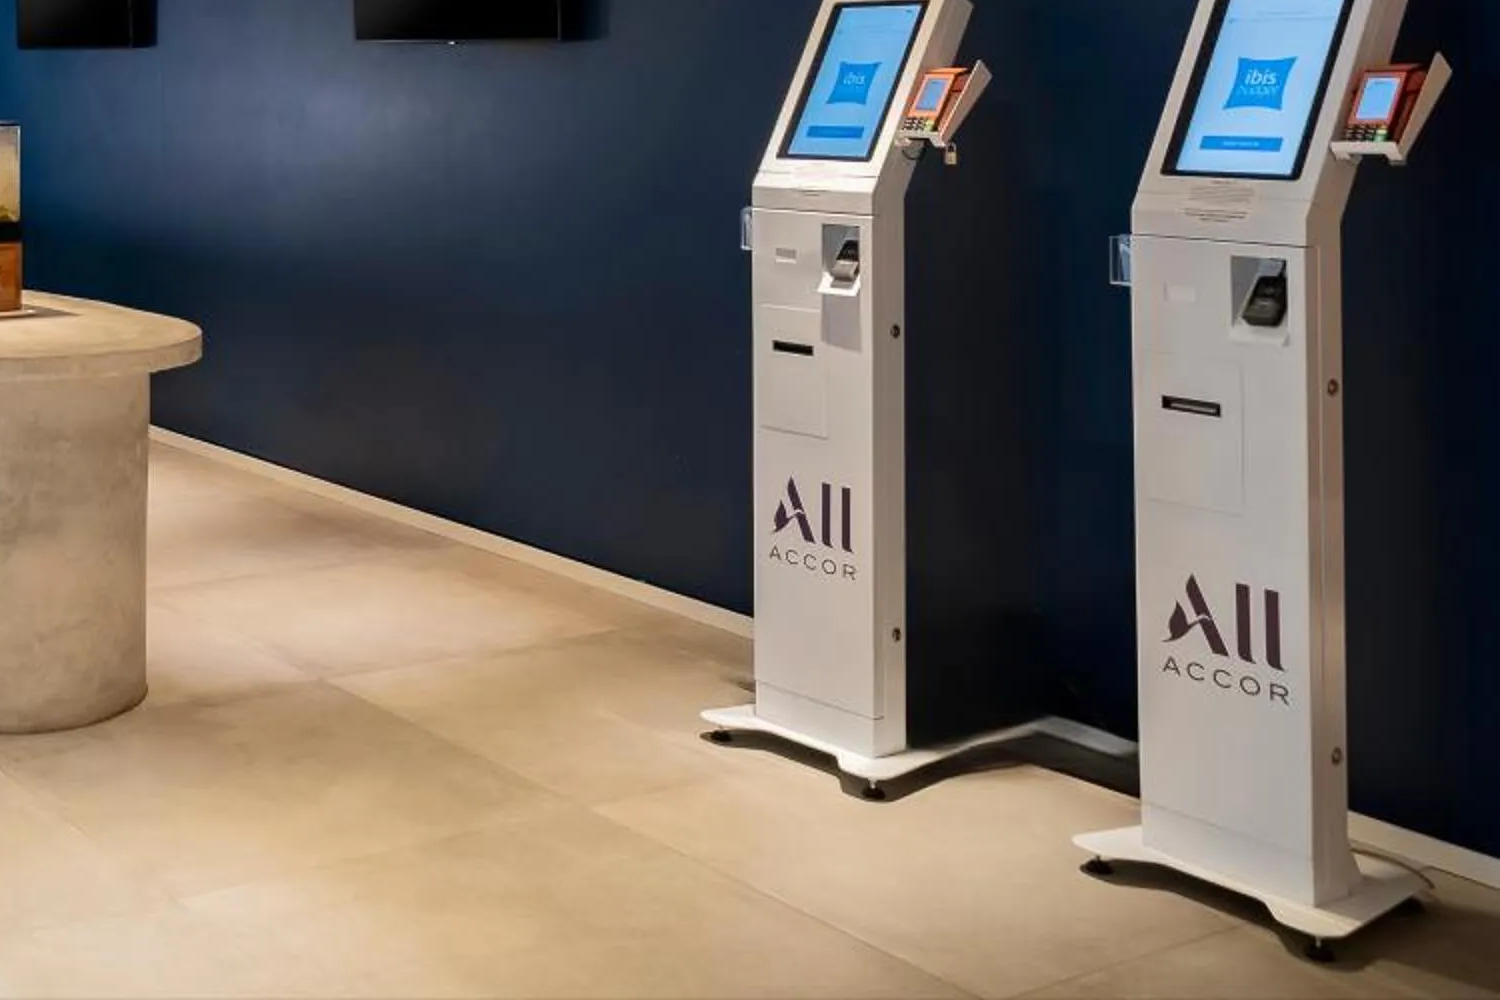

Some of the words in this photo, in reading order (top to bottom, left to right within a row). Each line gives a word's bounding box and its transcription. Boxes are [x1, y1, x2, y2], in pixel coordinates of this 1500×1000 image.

[1245, 68, 1277, 85] ibis
[769, 545, 857, 581] ACCOR
[1163, 656, 1289, 706] ACCOR
